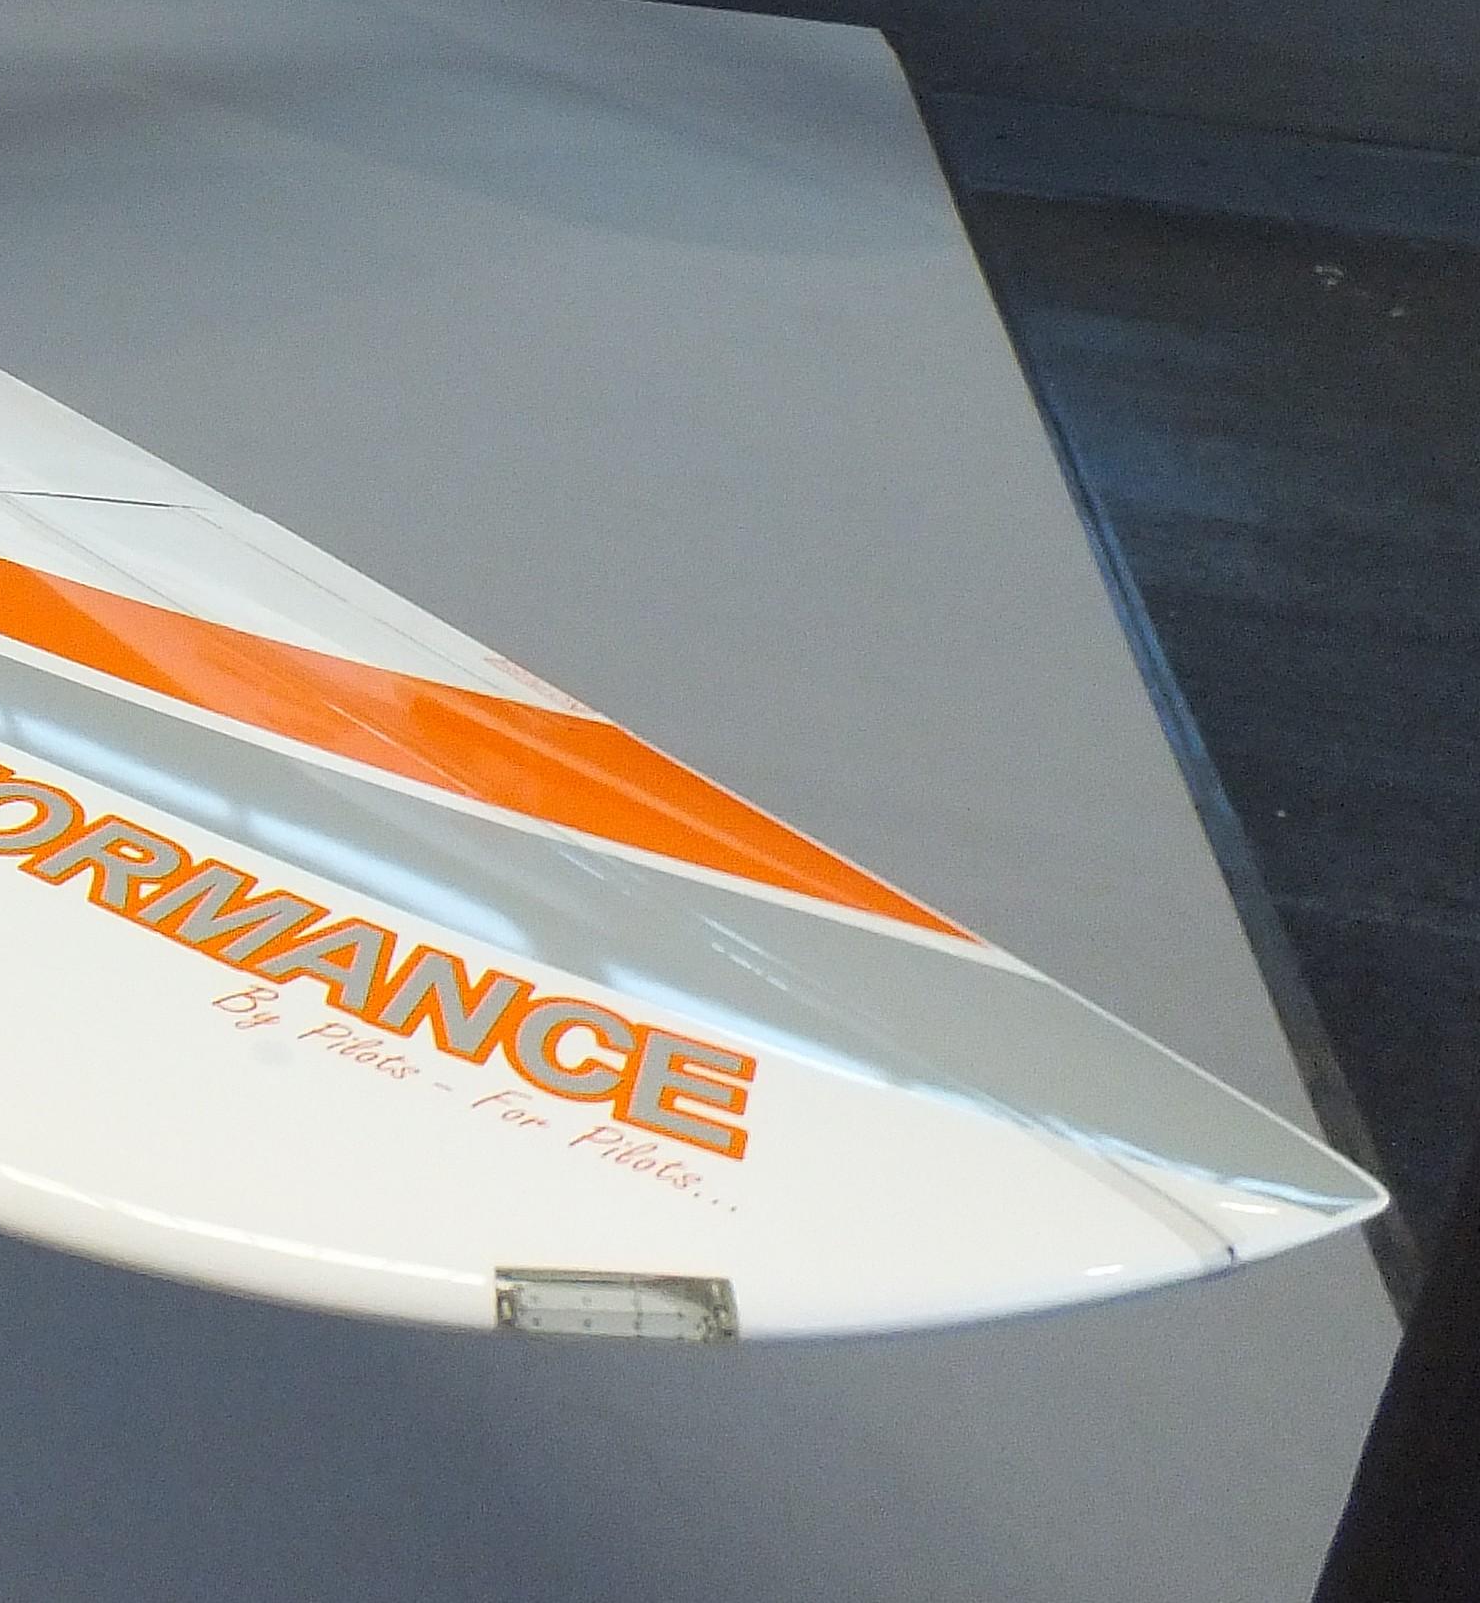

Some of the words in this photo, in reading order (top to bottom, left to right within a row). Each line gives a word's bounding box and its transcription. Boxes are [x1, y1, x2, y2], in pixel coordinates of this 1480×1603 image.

[211, 984, 281, 1030] By
[297, 1021, 422, 1081] Pilots
[471, 1089, 551, 1129] For
